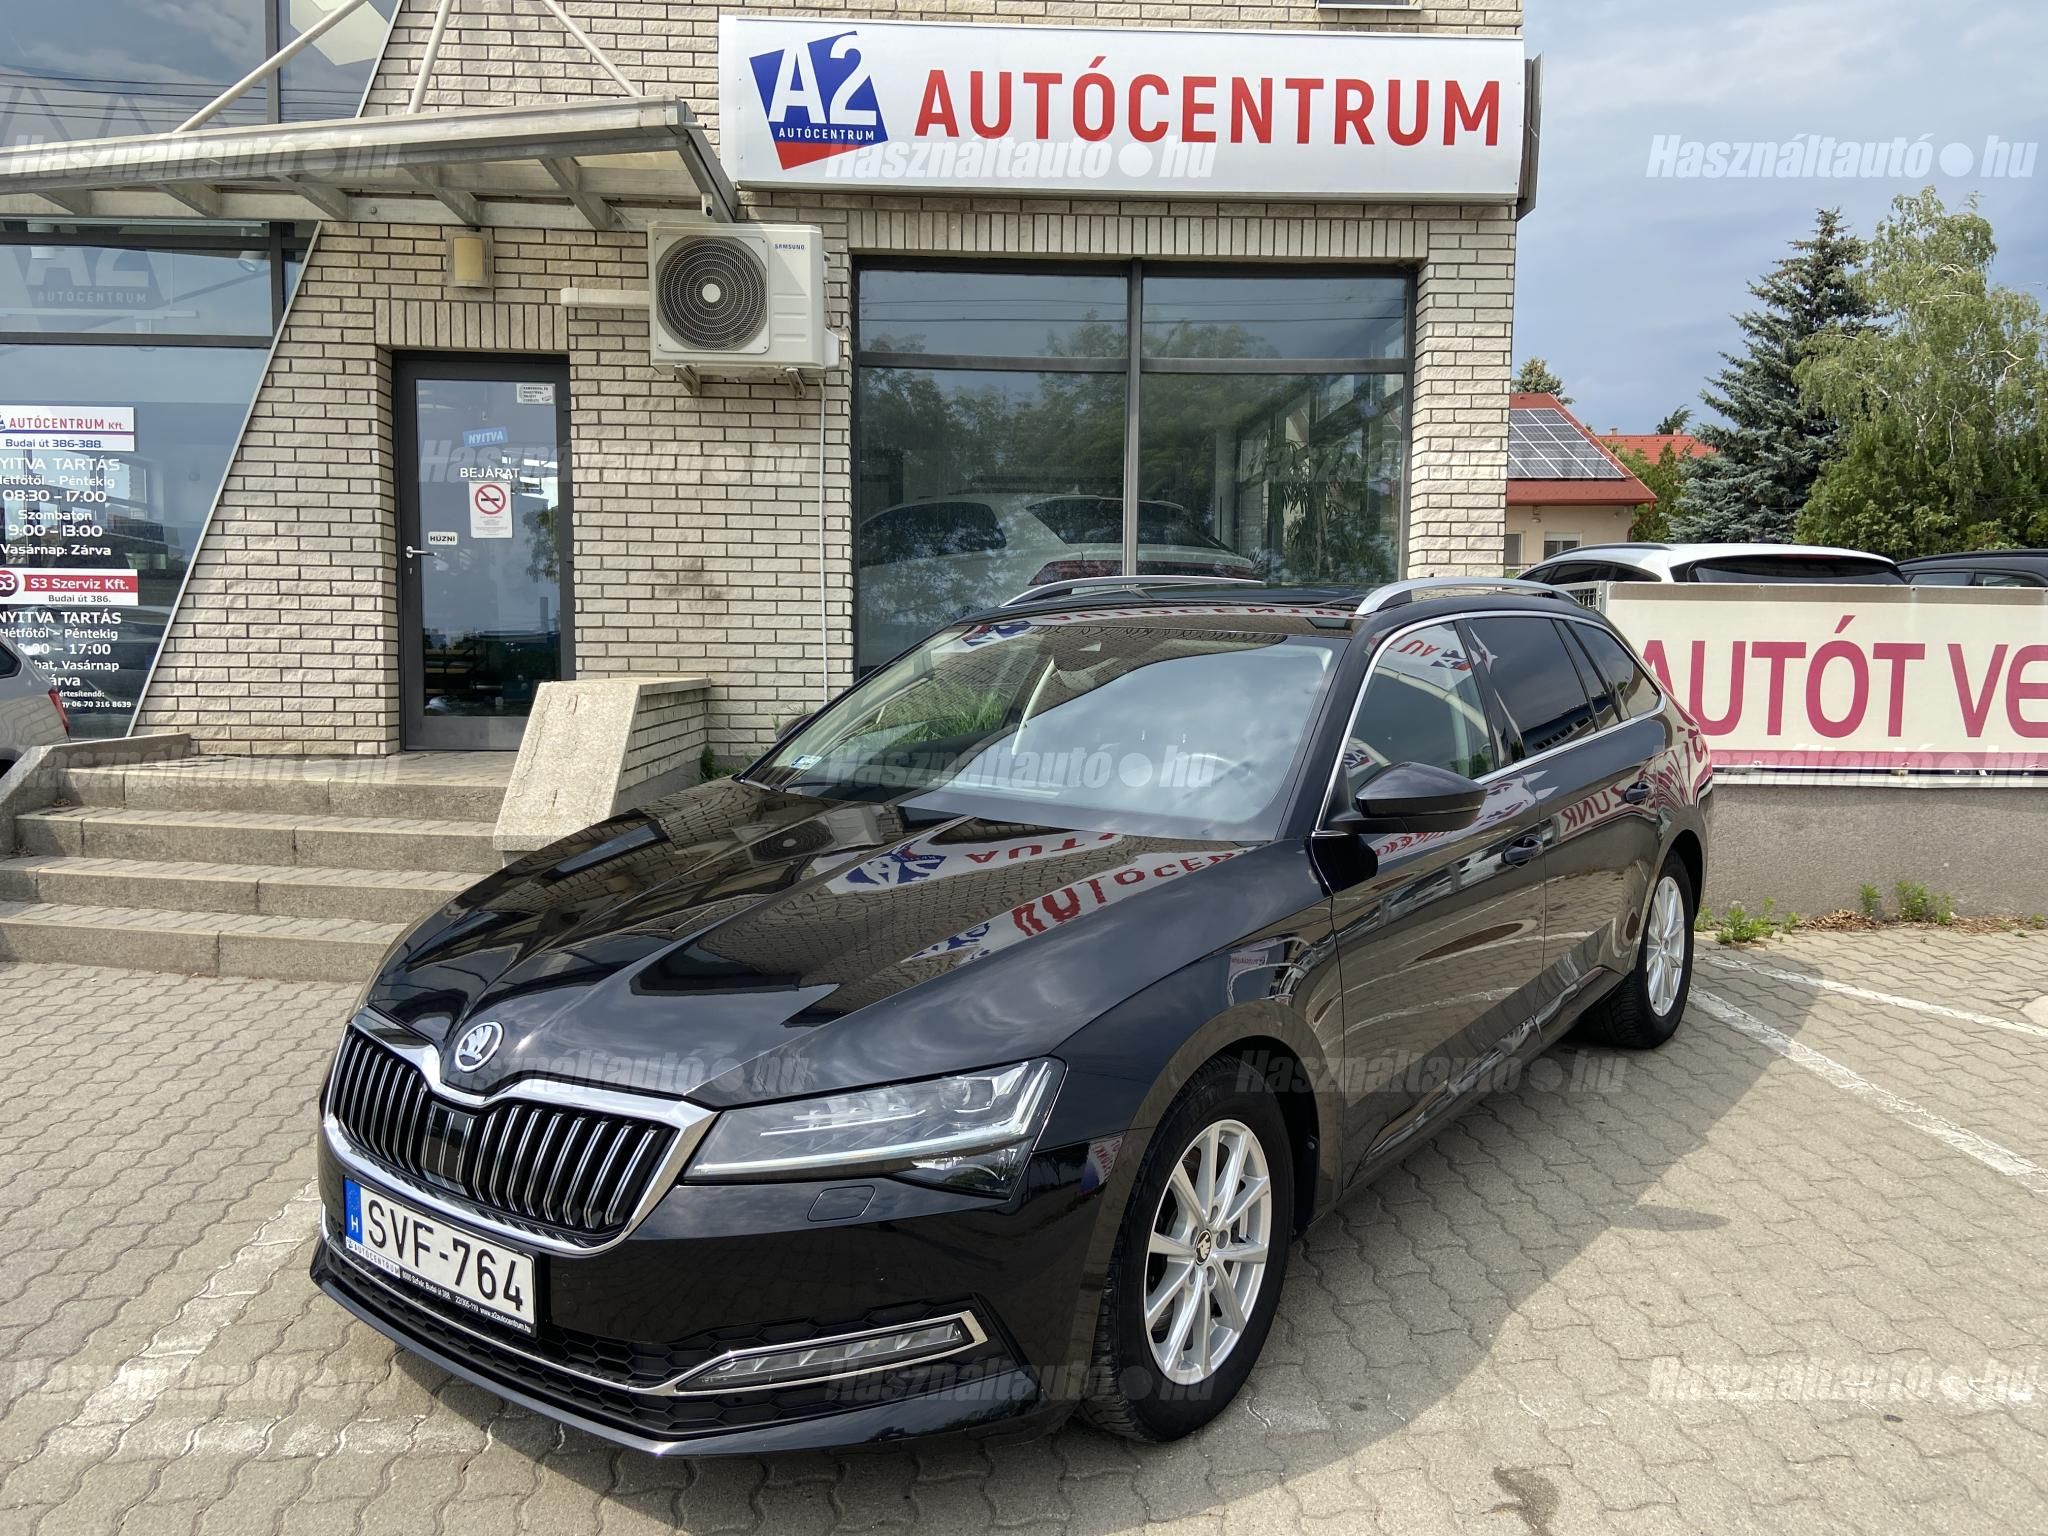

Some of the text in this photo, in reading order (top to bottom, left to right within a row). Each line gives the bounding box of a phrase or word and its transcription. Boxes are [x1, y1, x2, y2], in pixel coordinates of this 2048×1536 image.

[768, 34, 877, 126] A2
[914, 56, 1501, 147] AUTÓCENTRUM
[778, 126, 875, 141] AUTÓCENTRUM
[9, 416, 104, 429] AUTÓCENTRUM
[5, 439, 36, 447] Budai
[468, 431, 504, 444] NYITVA
[0, 455, 120, 471] YITVA TARTÁS
[460, 465, 520, 478] BEJÁRAT
[60, 476, 115, 489] Péntekig
[3, 489, 50, 502] 08:30
[66, 490, 107, 502] 17:00
[18, 509, 92, 521] Szombaton
[8, 524, 46, 537] 9:00
[62, 525, 103, 537] 13:00
[0, 544, 112, 557] Vasárnap: Zárva
[30, 577, 129, 590] S3 Szerviz Kft.
[48, 594, 112, 603] Budai út 386.
[60, 608, 122, 625] TARTÁS
[64, 628, 118, 641] Péntekig
[70, 643, 111, 655] 17:00
[62, 660, 119, 672] Vasárnap
[50, 674, 81, 686] árva
[1642, 614, 1926, 739] AUTÓT
[351, 1214, 358, 1233] H
[369, 1199, 523, 1312] SVF-764
